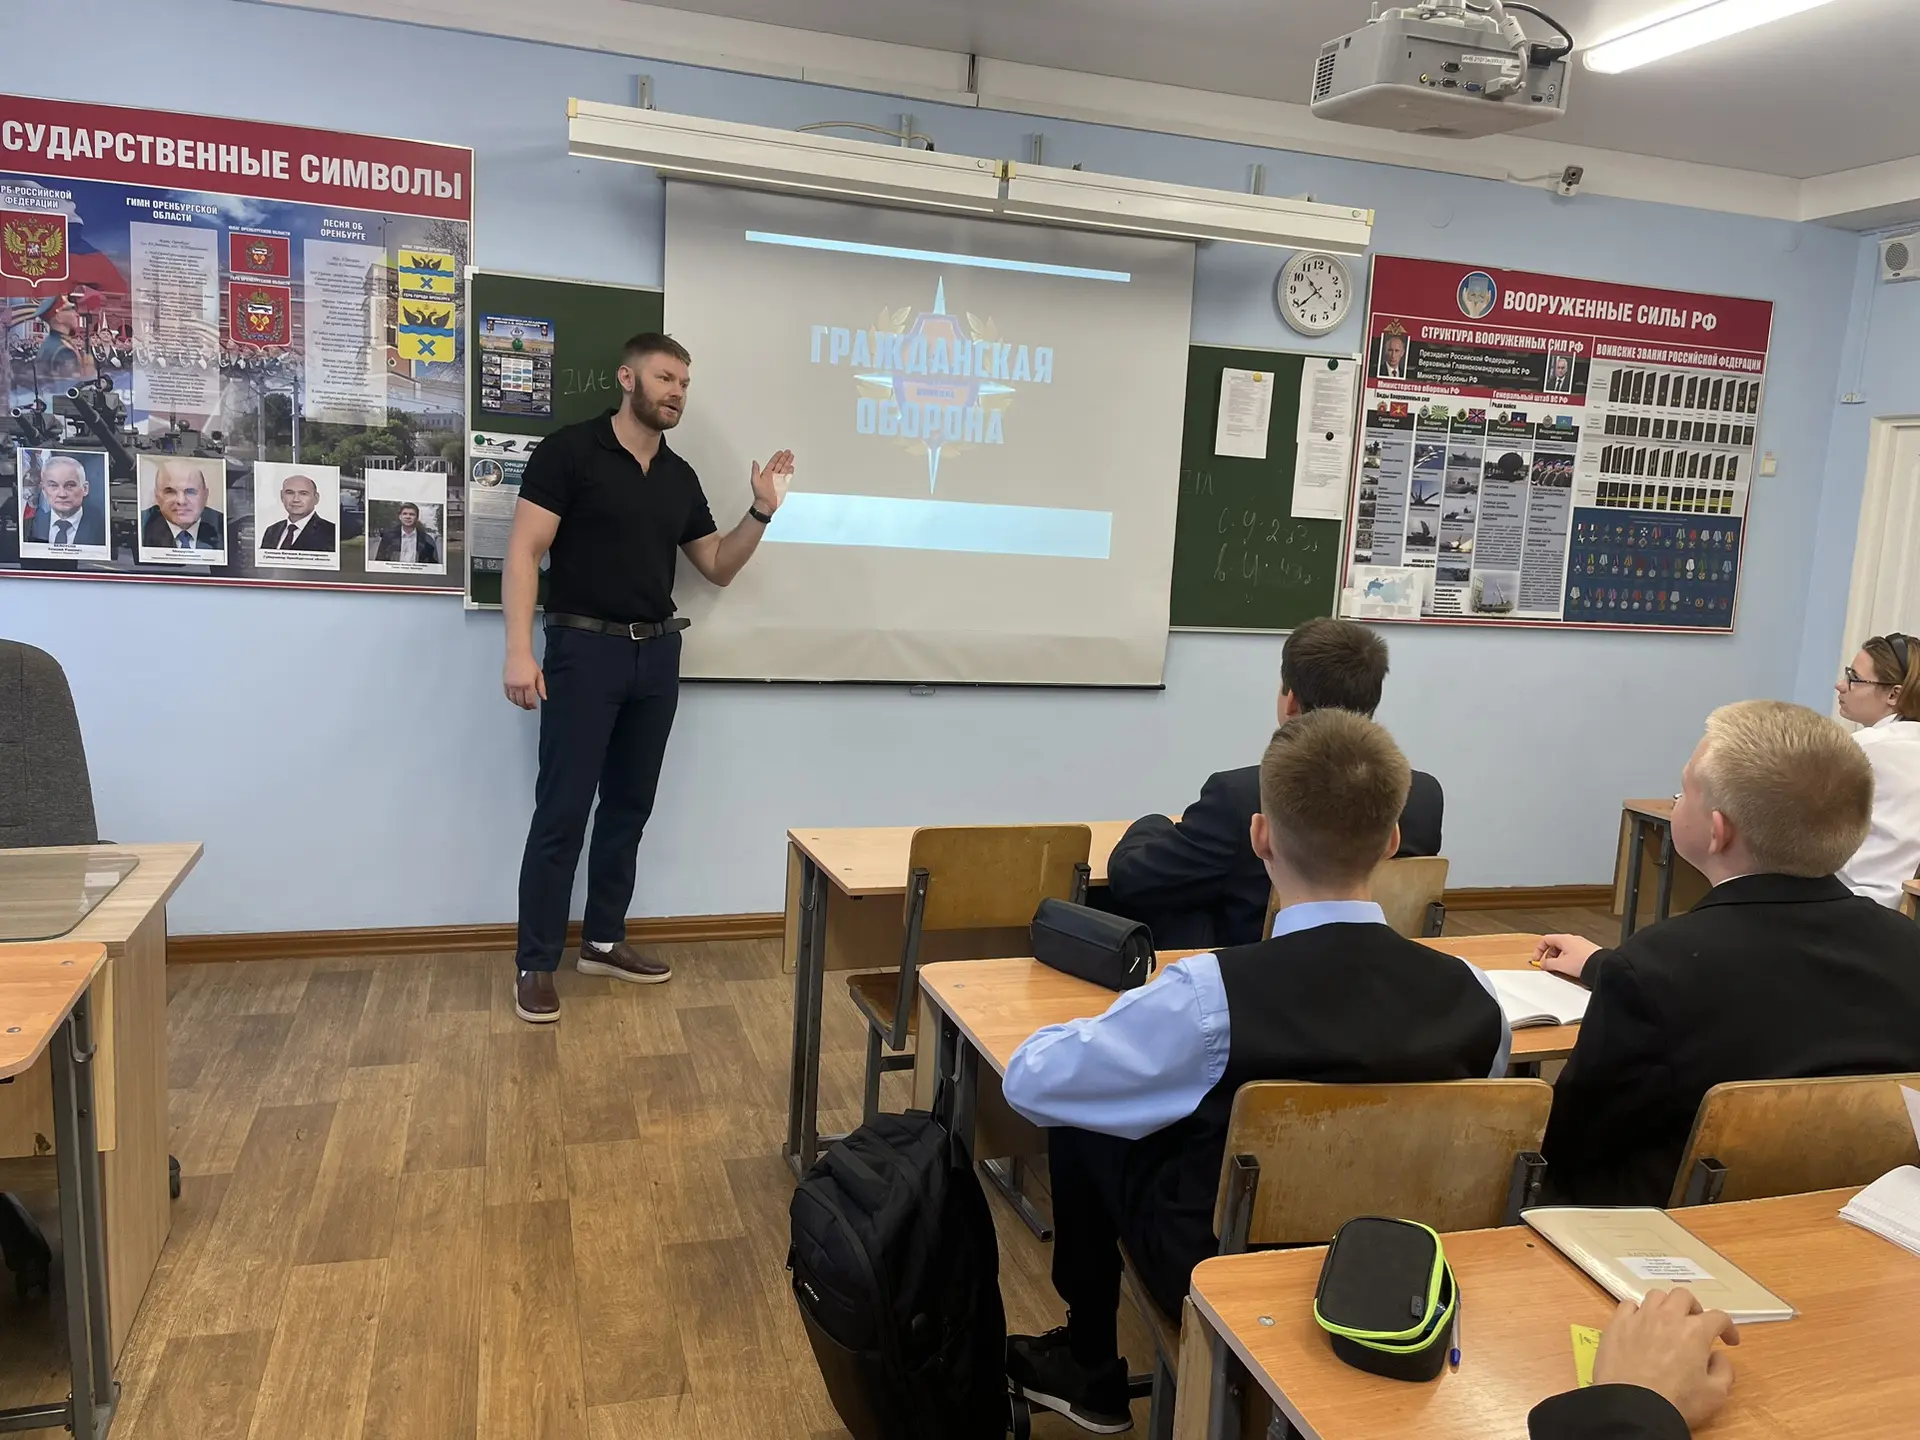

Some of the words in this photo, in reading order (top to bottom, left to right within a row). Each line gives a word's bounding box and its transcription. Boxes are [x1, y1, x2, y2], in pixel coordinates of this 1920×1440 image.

[2, 119, 290, 180] СУДАРСТВЕННЫЕ
[300, 153, 462, 201] СИМВОЛЫ
[15, 186, 73, 200] РОССИЙСКОЙ
[5, 196, 60, 209] ФЕДЕРАЦИИ
[126, 197, 151, 208] ГИМН
[152, 200, 219, 215] ОРЕНБУРГСКОЙ
[153, 211, 193, 223] ОБЛАСТИ
[323, 218, 350, 230] ПЕСНЯ
[352, 221, 364, 231] ОБ
[320, 229, 367, 241] ОРЕНБУРГЕ
[1302, 262, 1312, 273] 11
[1313, 260, 1324, 270] 12
[1328, 265, 1333, 275] 1
[1293, 272, 1305, 282] 10
[1332, 276, 1339, 286] 2
[1290, 285, 1297, 295] 9
[1335, 289, 1342, 299] 3
[1292, 299, 1301, 308] 8
[1329, 302, 1337, 311] 4
[1301, 309, 1307, 319] 7
[1322, 311, 1330, 321] 5
[1503, 289, 1633, 325] ВООРУЖЕННЫЕ
[1637, 305, 1687, 329] СИЛЫ
[1691, 312, 1718, 332] РФ
[1310, 314, 1317, 324] 6
[1421, 325, 1474, 344] СТРУКТУРА
[1475, 331, 1547, 350] ВООРУЖЕННЫХ
[1547, 338, 1568, 353] СИЛ
[1568, 341, 1584, 354] РФ
[809, 324, 1054, 384] ГРАЖДАНСКАЯ
[1419, 348, 1450, 360] Президент
[1450, 352, 1483, 362] Российской
[1484, 355, 1515, 366] Федерации
[1596, 343, 1636, 359] ВОИНСКИЕ
[1636, 346, 1668, 362] ЗВАНИЯ
[1668, 350, 1718, 368] РОССИЙСКОЙ
[1718, 355, 1762, 372] ФЕДЕРАЦИИ
[1418, 358, 1451, 369] Верховный
[1451, 361, 1511, 374] Главнокомандующий
[1511, 367, 1521, 375] ВС
[1521, 368, 1531, 376] РФ
[1416, 371, 1442, 382] Министр
[1442, 374, 1468, 384] обороны
[1468, 375, 1479, 384] РФ
[1377, 380, 1422, 392] Министерство
[1422, 383, 1450, 394] обороны
[1450, 386, 1461, 395] РФ
[1492, 390, 1534, 401] Генеральный
[1534, 393, 1550, 403] штаб
[1550, 395, 1559, 404] ВС
[1559, 396, 1569, 405] РФ
[856, 397, 1005, 445] ОБОРОНА
